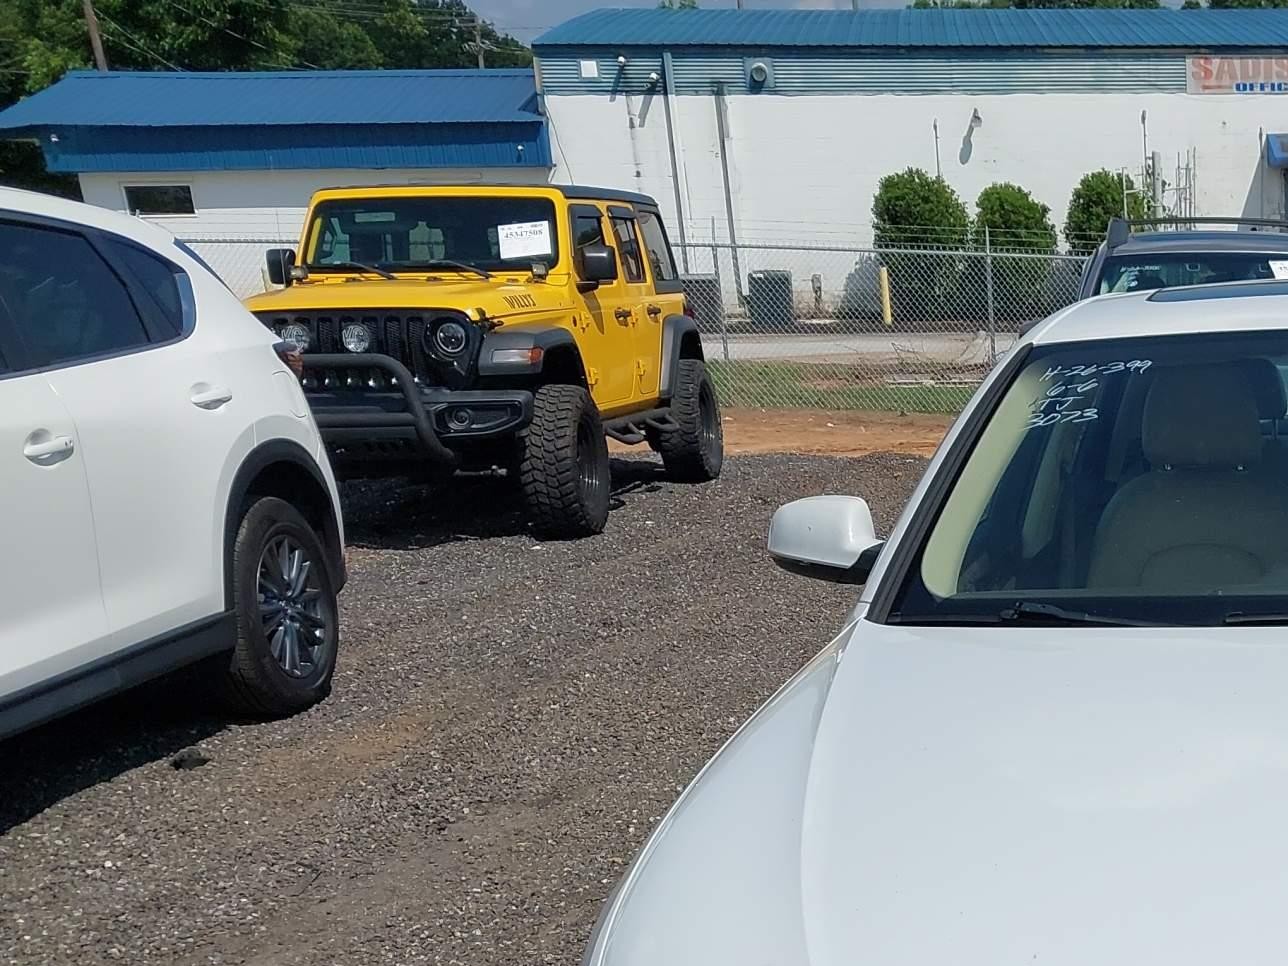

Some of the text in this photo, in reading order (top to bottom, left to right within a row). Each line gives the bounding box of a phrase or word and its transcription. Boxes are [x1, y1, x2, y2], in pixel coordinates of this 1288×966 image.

[1040, 359, 1152, 382] H-26-399
[1046, 378, 1099, 396] 6-6
[1024, 408, 1099, 430] 3073
